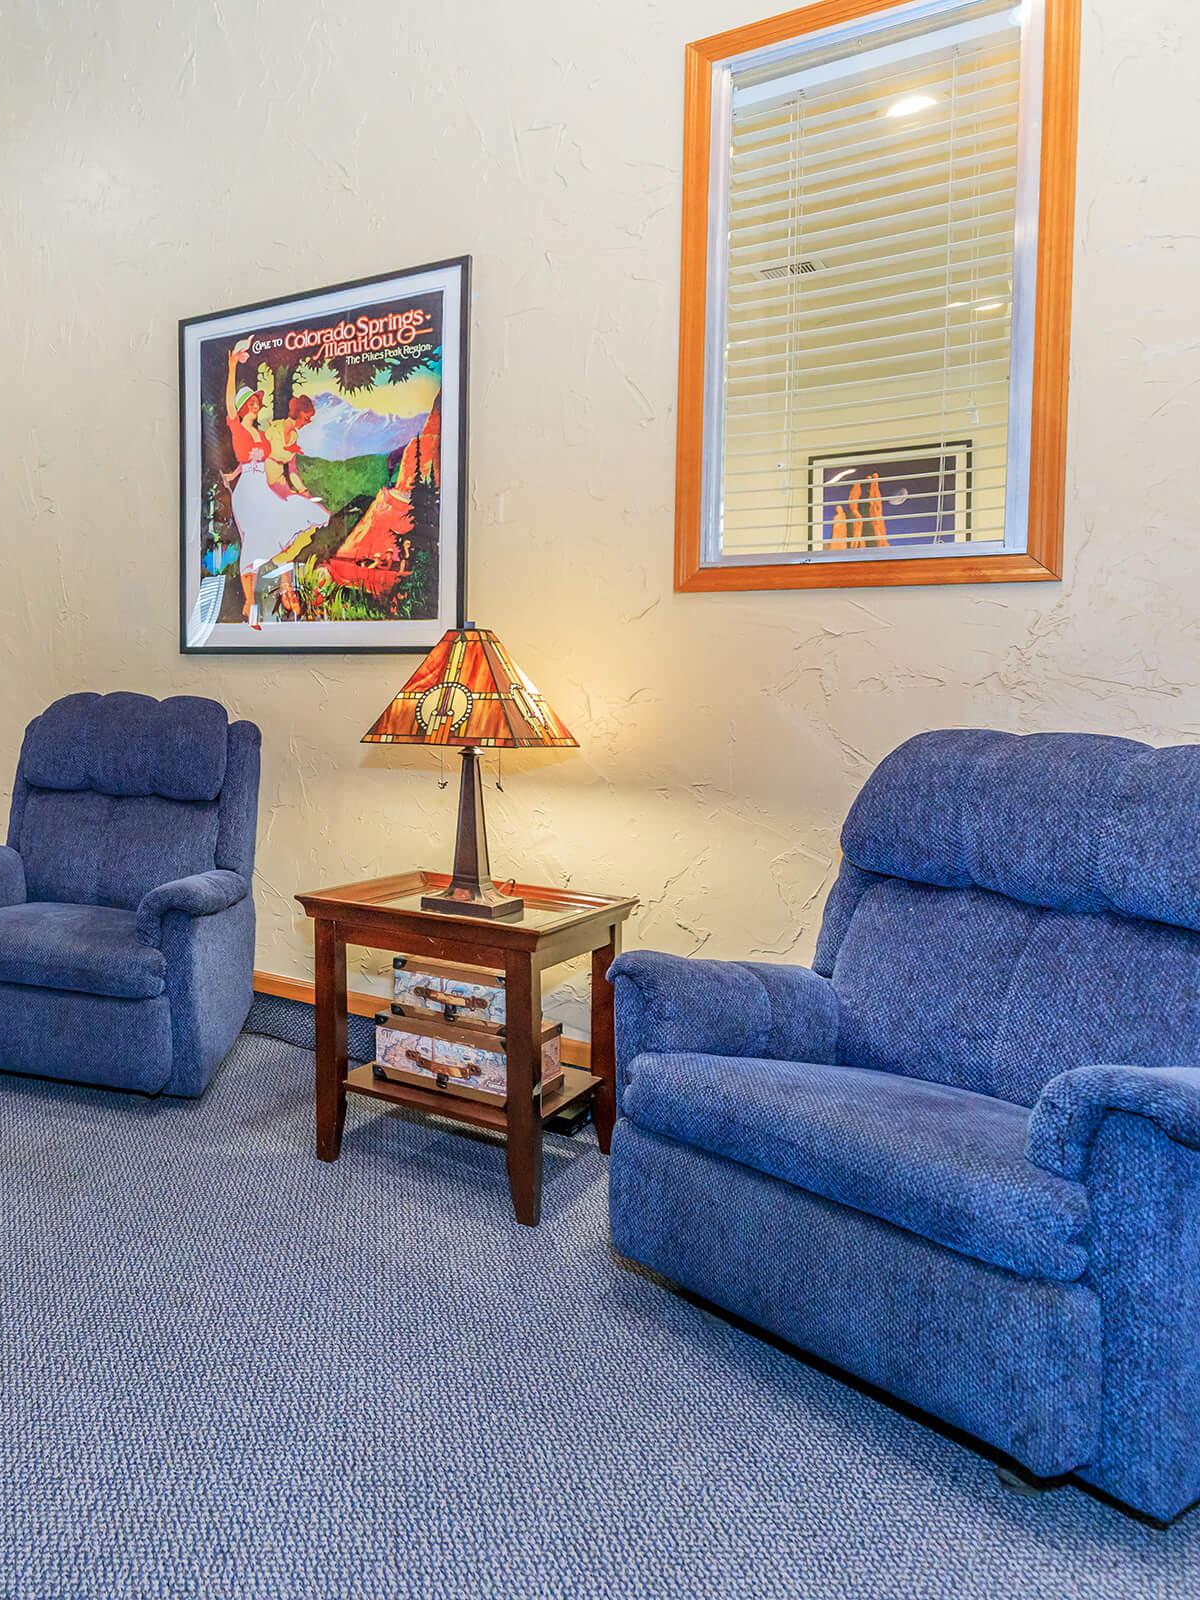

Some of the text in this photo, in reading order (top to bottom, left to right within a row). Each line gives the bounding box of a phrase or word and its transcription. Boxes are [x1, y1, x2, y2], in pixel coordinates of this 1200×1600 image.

[272, 338, 283, 347] TO
[285, 320, 356, 350] Colorado
[346, 344, 431, 365] The Pikes Peak Region
